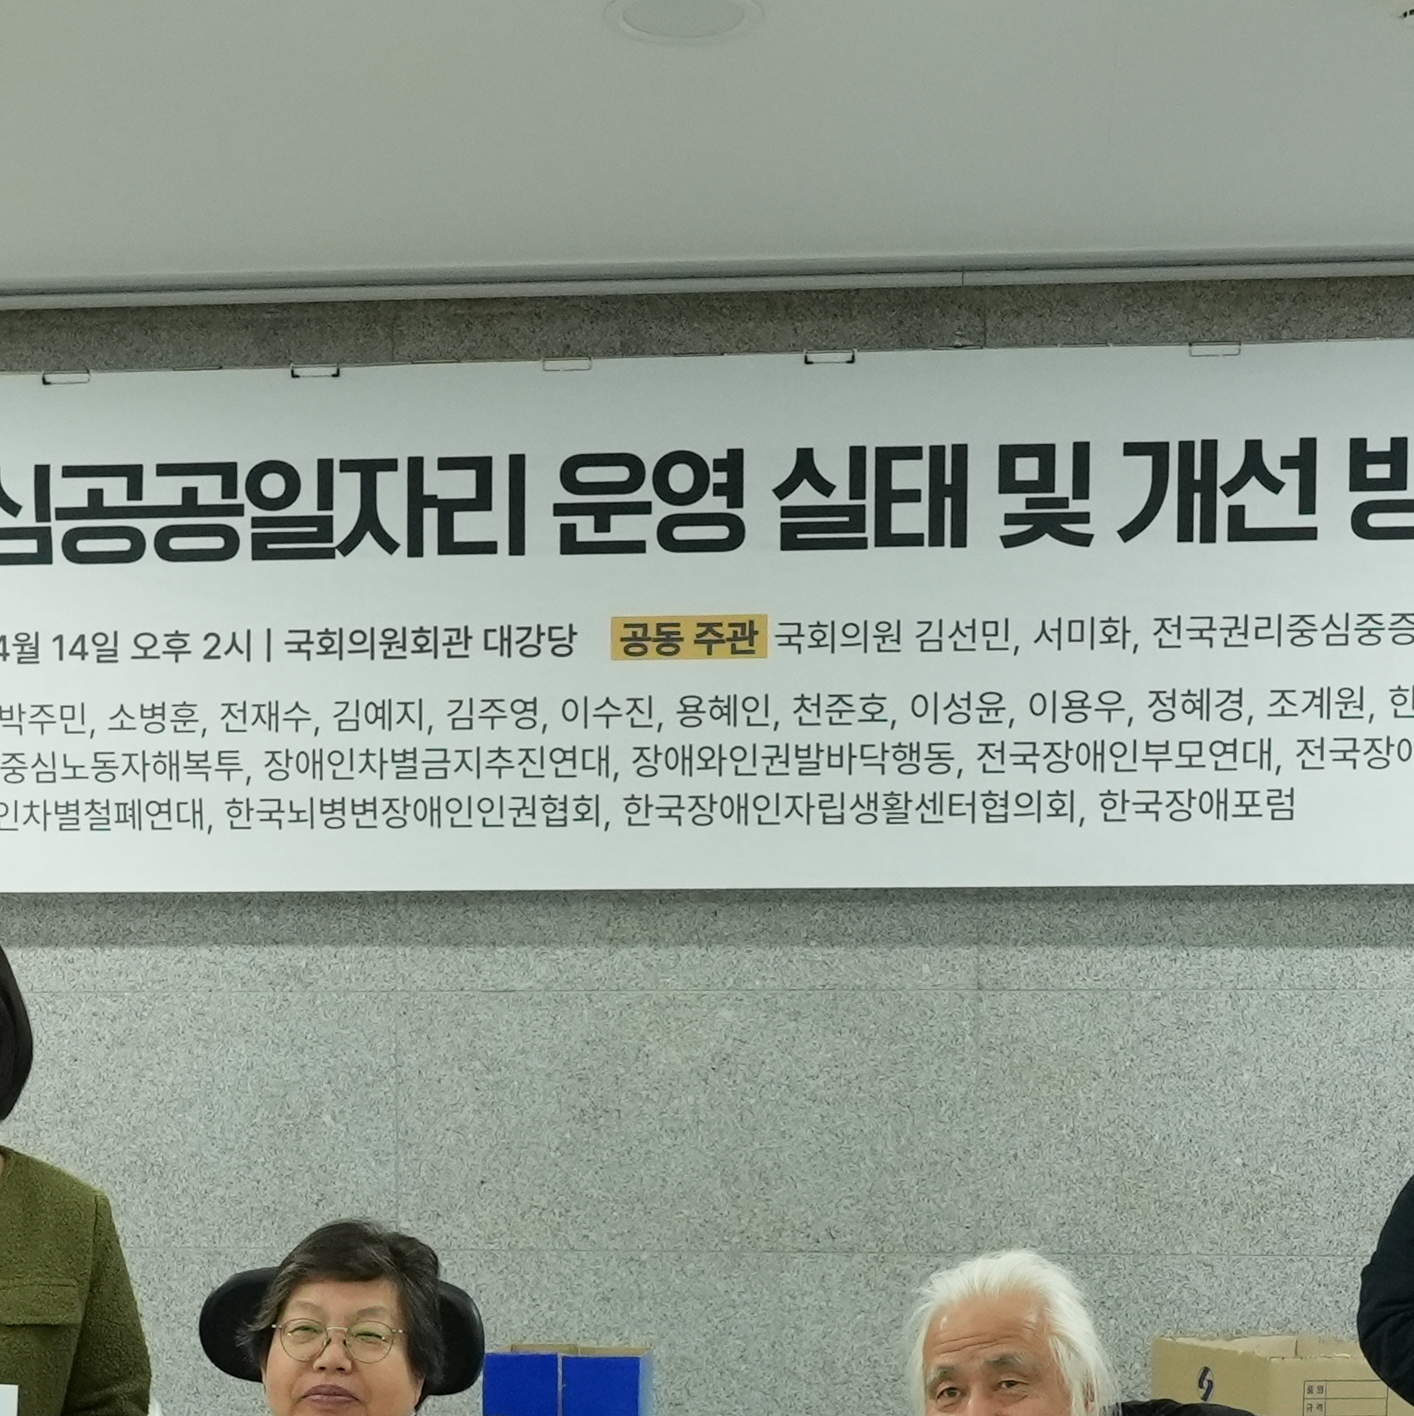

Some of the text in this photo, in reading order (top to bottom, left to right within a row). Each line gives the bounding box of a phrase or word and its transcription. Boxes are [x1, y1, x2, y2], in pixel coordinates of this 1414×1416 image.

[553, 448, 745, 555] 운영
[772, 444, 968, 551] 실태
[998, 441, 1094, 548] 및
[1117, 437, 1317, 543] 개선
[53, 631, 118, 663] 14일
[131, 630, 191, 663] 오후
[203, 629, 250, 662] 2시
[285, 625, 473, 661] 국회의원회관
[484, 624, 577, 658] 대강당
[619, 620, 759, 656] 공동 주관
[775, 620, 901, 654] 국회의원
[916, 618, 1019, 656] 김선민,
[1034, 616, 1138, 654] 서미화,
[0, 702, 94, 739] 박주민,
[108, 701, 206, 738] 소병훈,
[221, 700, 319, 736] 전재수,
[334, 698, 432, 735] 김예지,
[447, 697, 547, 734] 김주영,
[562, 695, 662, 732] 이수진,
[677, 694, 779, 731] 용혜인,
[793, 693, 896, 730] 천준호,
[912, 691, 1014, 728] 이성윤,
[1030, 690, 1133, 727] 이용우,
[1148, 688, 1253, 725] 정혜경,
[1268, 686, 1374, 724] 조계원,
[265, 745, 618, 782] 장애인차별금지추진연대,
[633, 742, 962, 779] 장애와인권발바닥행동,
[977, 738, 1281, 775] 전국장애인부모연대,
[225, 794, 609, 831] 한국뇌병변장애인인권협회,
[623, 790, 1084, 827] 한국장애인자립생활센터협의회,
[1099, 787, 1294, 822] 한국장애포럼
